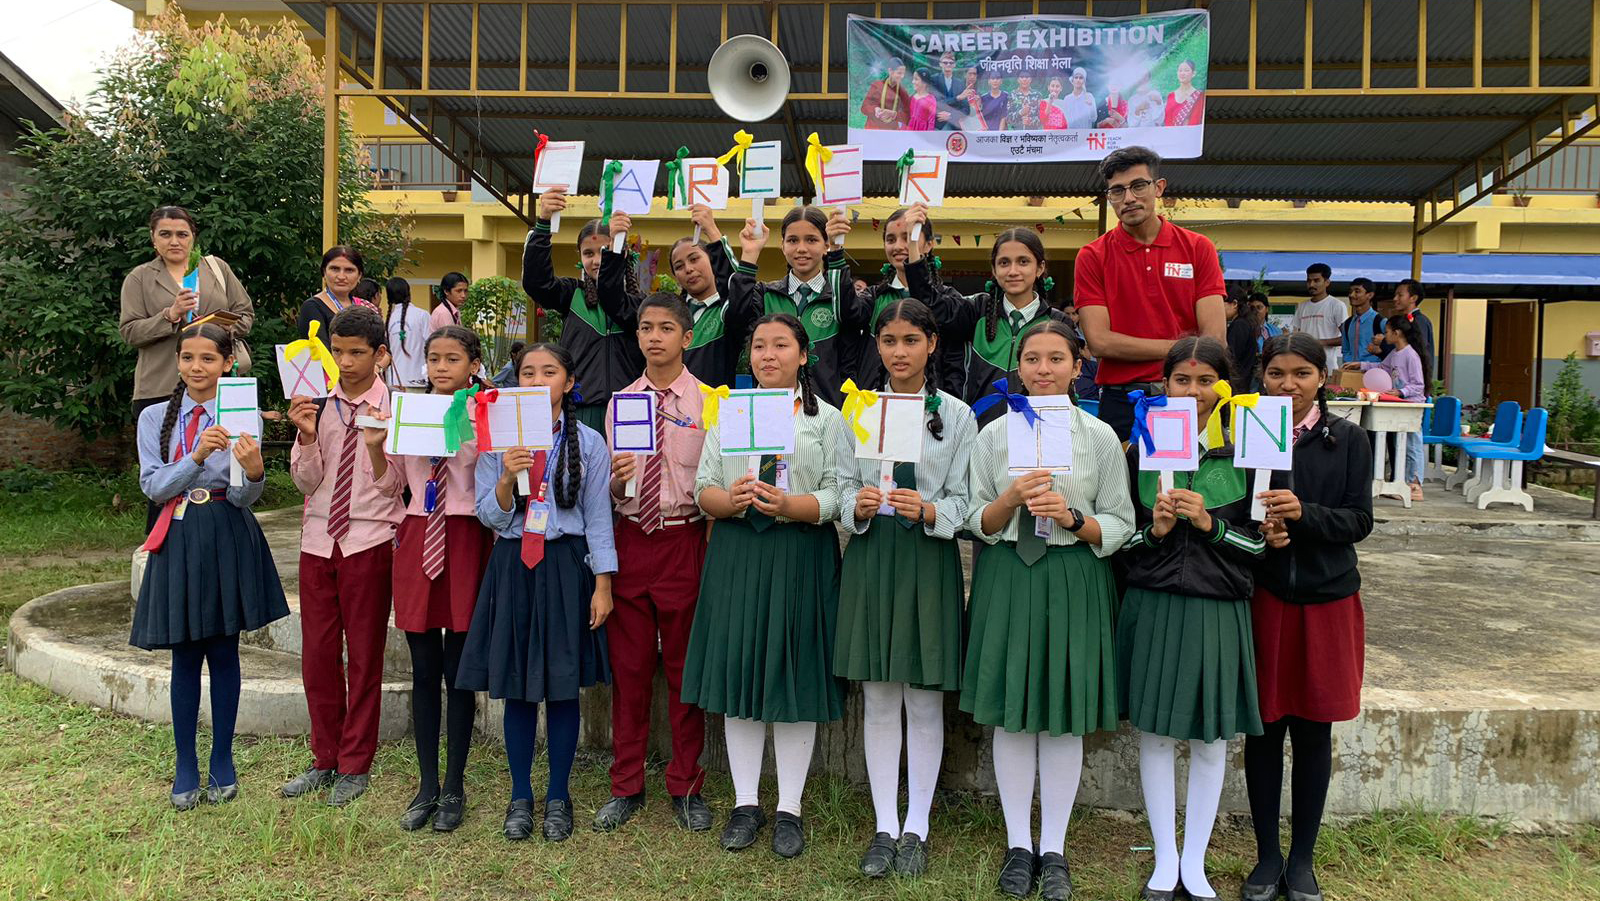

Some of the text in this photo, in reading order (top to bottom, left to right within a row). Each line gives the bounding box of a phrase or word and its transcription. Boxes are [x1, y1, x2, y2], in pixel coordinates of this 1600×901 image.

[911, 23, 1165, 53] CAREER EXHIBITION
[1024, 54, 1049, 70] शिक्षा
[1051, 53, 1072, 70] मेला
[975, 135, 999, 144] आजका
[600, 168, 649, 207] A
[687, 163, 719, 205] R
[742, 144, 776, 194] E
[819, 147, 860, 205] E
[903, 155, 941, 203] R
[281, 350, 321, 397] X
[216, 382, 258, 441] E
[1241, 404, 1287, 459] N
